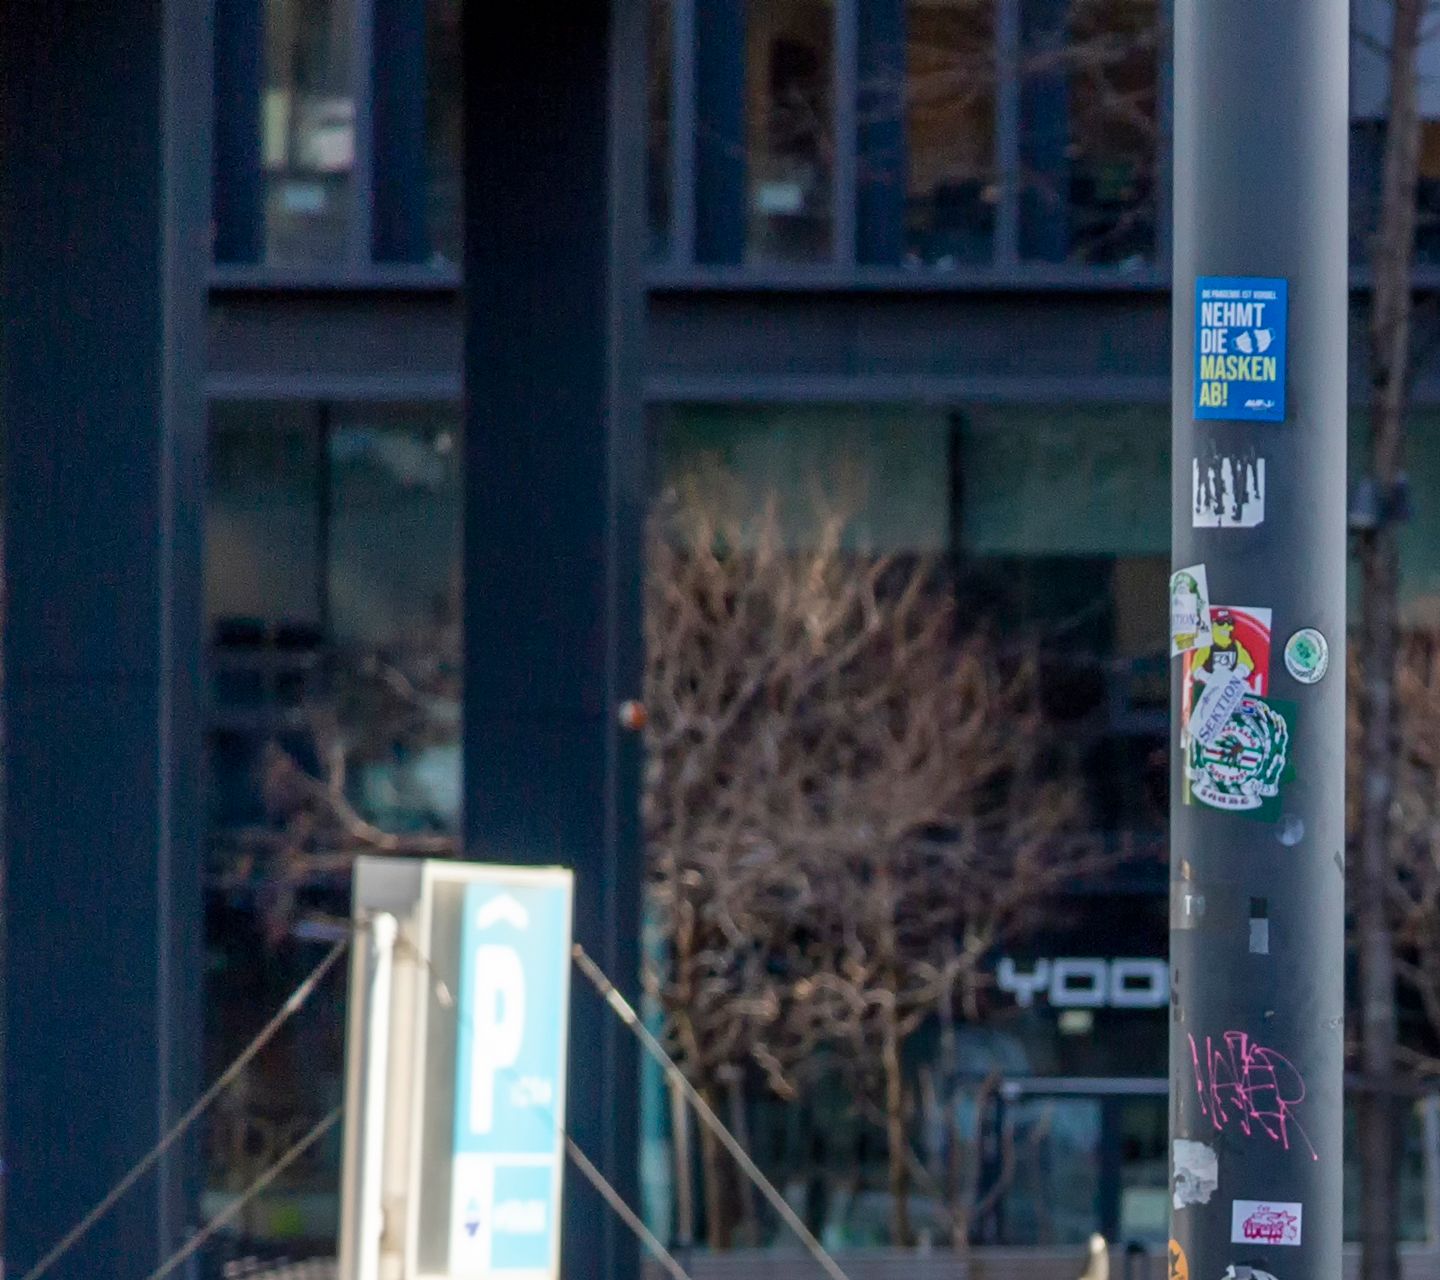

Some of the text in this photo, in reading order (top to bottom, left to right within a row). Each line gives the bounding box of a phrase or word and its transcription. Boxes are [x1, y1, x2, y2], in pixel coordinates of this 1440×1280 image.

[1201, 302, 1265, 328] NEHMT
[1201, 328, 1228, 354] DIE
[1200, 355, 1276, 381] MASKEN
[1199, 381, 1228, 407] AB!
[1199, 675, 1242, 743] SEKTION
[996, 956, 1169, 1008] YOO
[469, 943, 526, 1136] P
